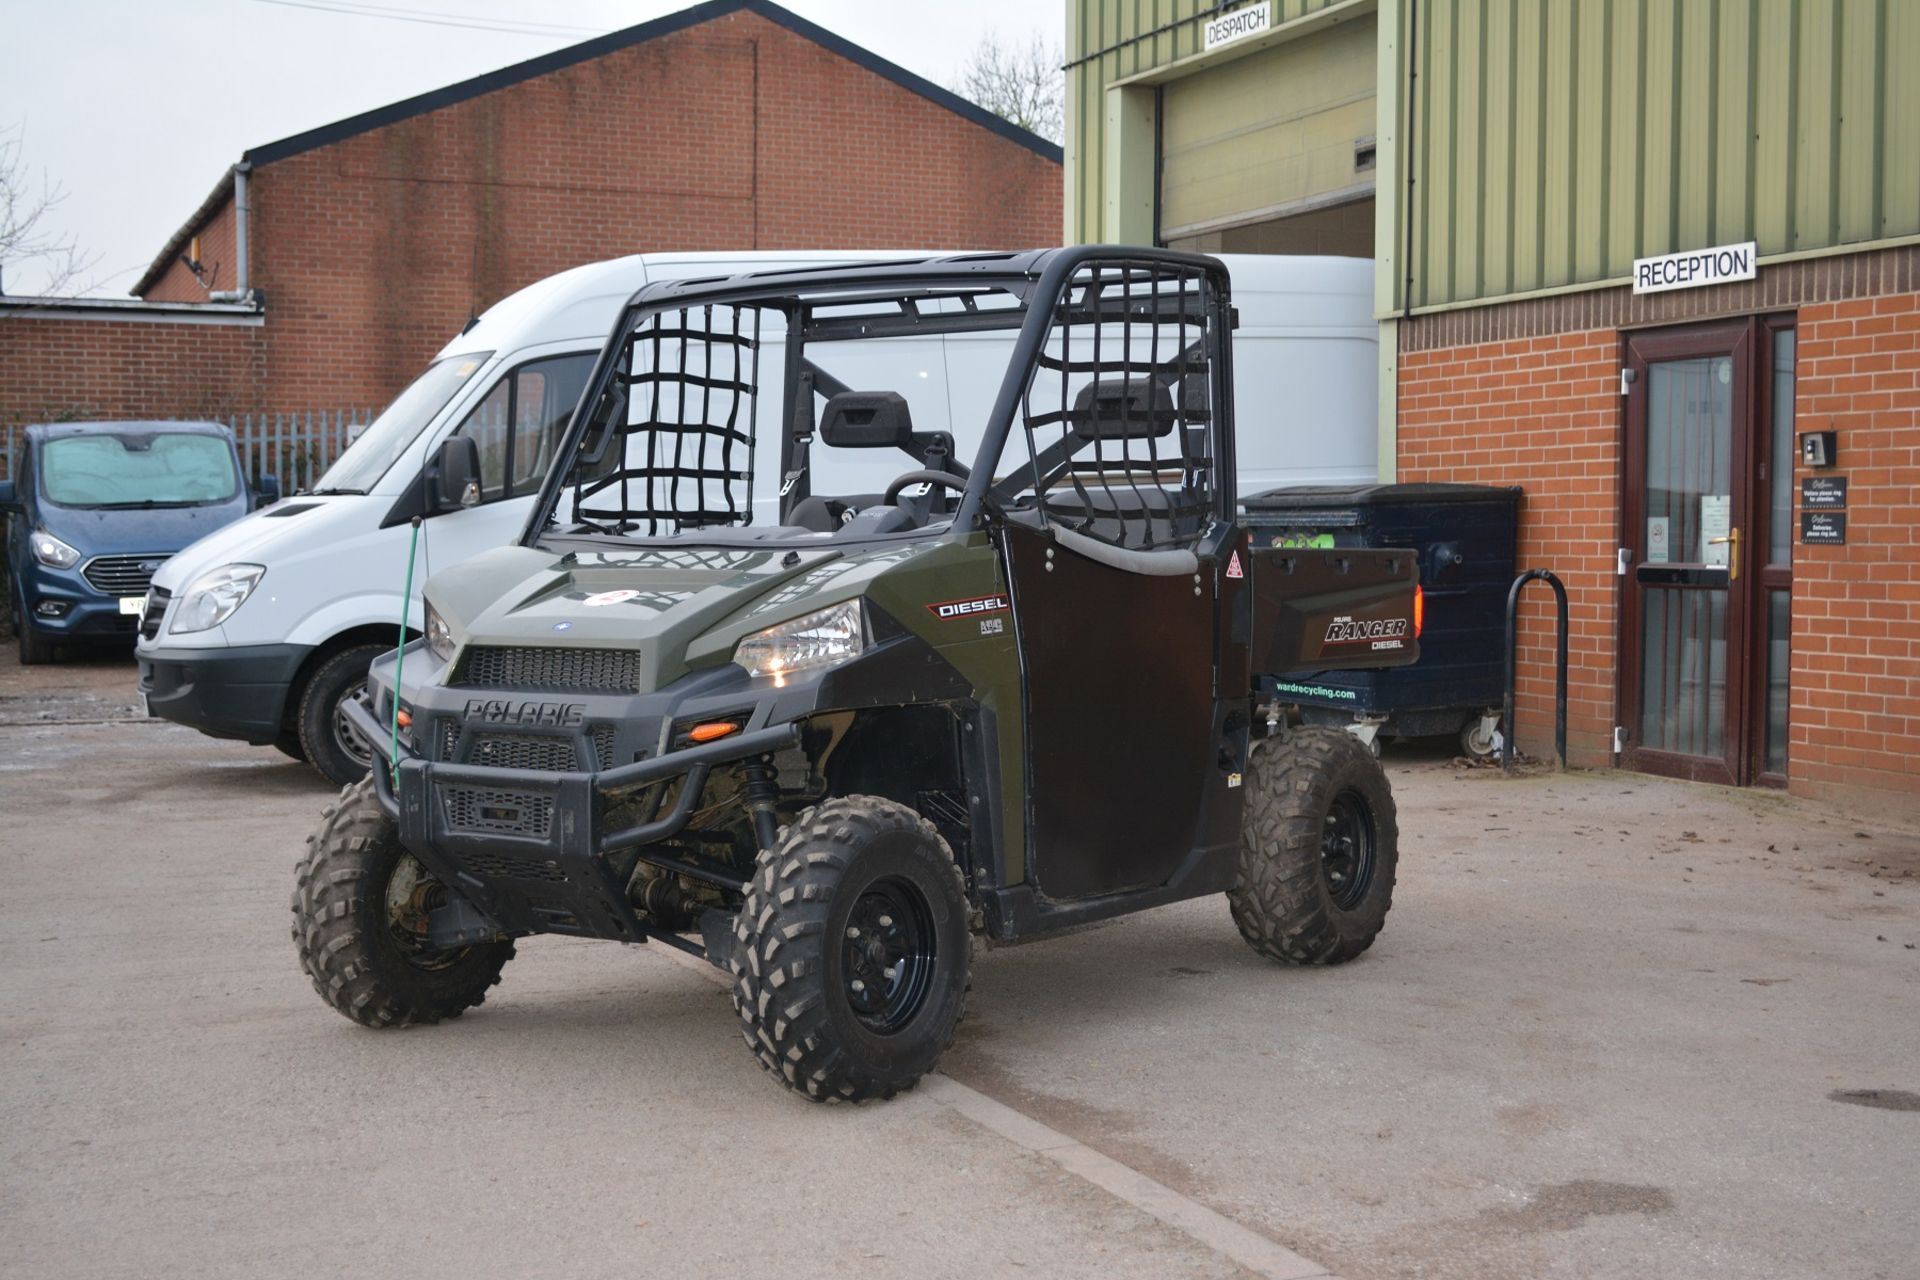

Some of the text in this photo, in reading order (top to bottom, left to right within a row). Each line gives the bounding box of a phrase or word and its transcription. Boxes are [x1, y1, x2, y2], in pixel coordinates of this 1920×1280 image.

[1208, 7, 1265, 44] DESPATCH
[1639, 249, 1748, 287] RECEPTION
[939, 597, 1008, 617] DIESEL
[1324, 618, 1407, 642] RANGER
[1372, 640, 1404, 650] DIESEL
[1276, 682, 1356, 700] wardrecycling.com
[464, 699, 587, 727] POLARIS
